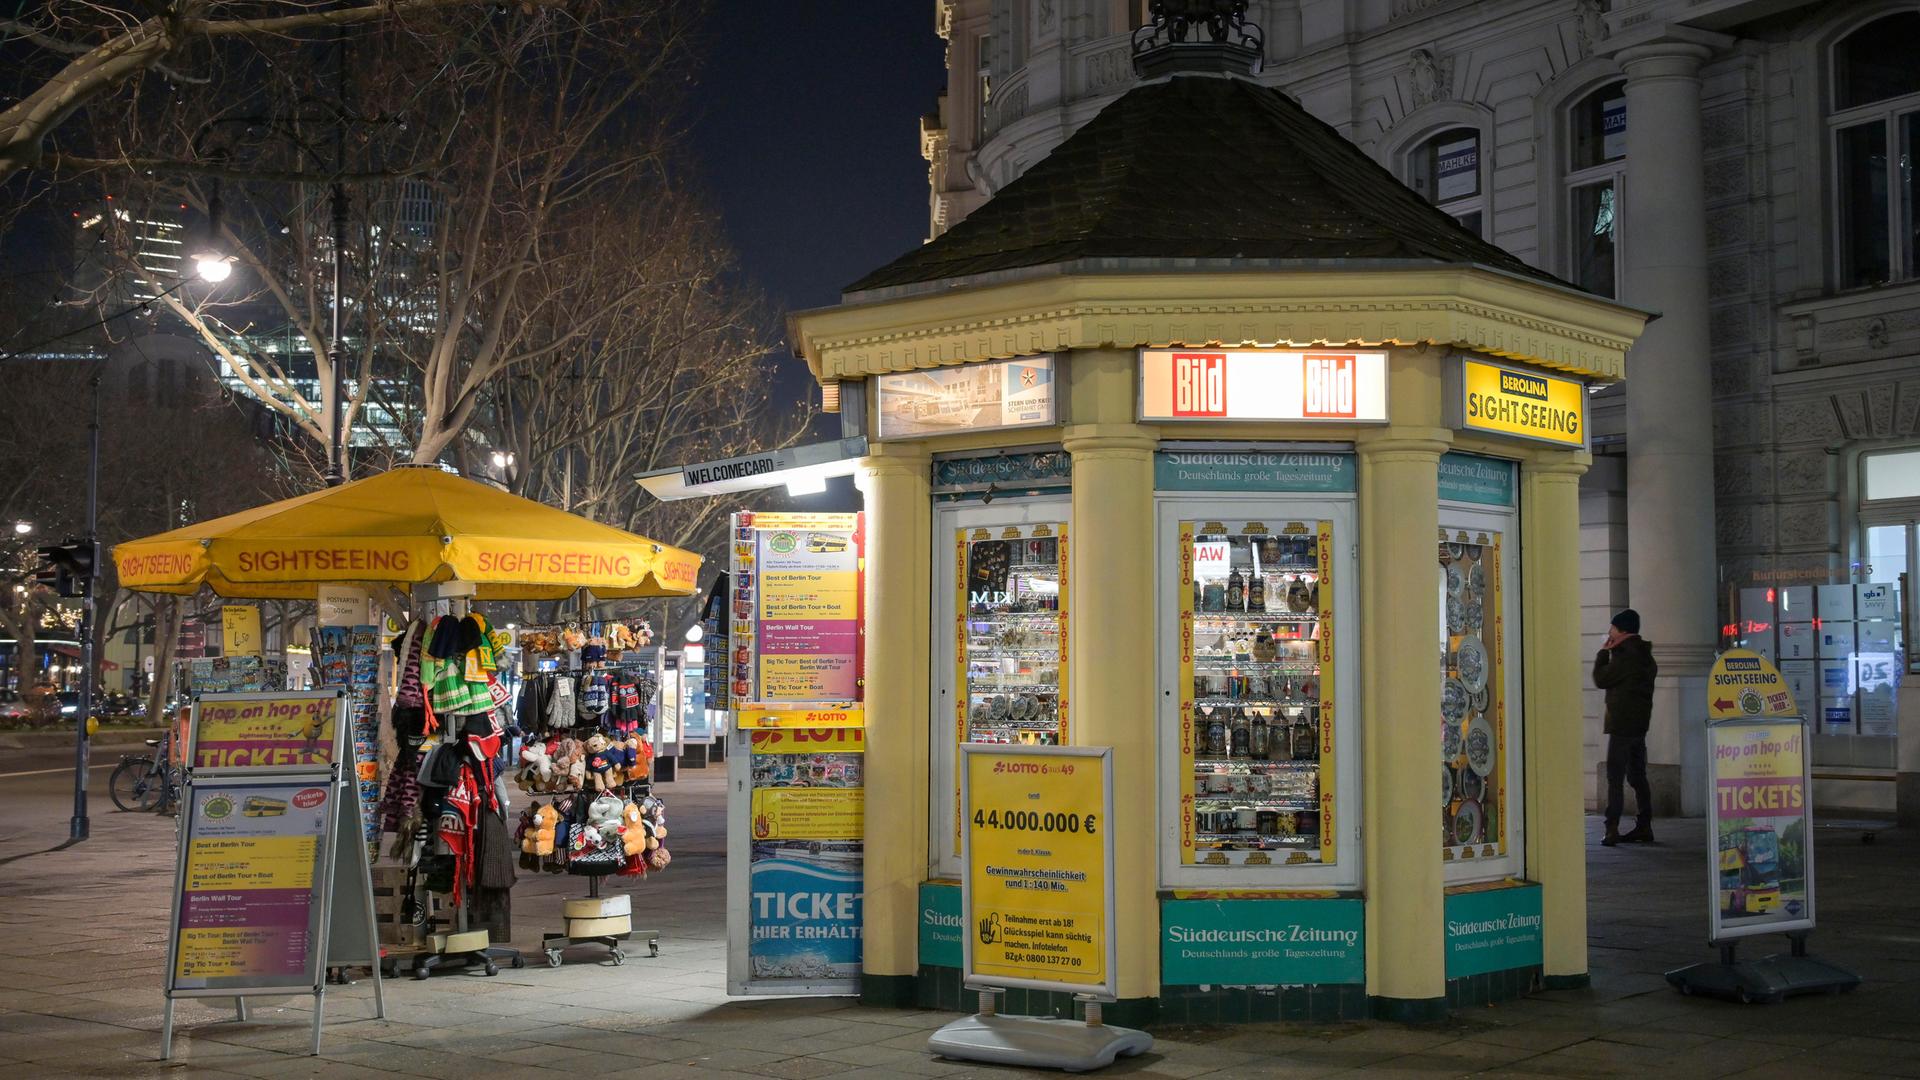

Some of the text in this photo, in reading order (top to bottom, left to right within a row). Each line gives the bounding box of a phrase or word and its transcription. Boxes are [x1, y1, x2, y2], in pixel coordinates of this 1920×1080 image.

[1439, 153, 1476, 173] MAHLKE
[1177, 358, 1223, 413] Bild
[1307, 360, 1353, 413] Bild
[1502, 375, 1547, 397] BEROLINA
[1469, 392, 1578, 435] SIGHTSEEING
[688, 458, 774, 485] WELCOMECARD
[1178, 470, 1332, 482] Deutschlands große Tageszeitung
[121, 553, 192, 576] SIGHTSEEING
[239, 549, 409, 572] SIGHTSEEING
[478, 552, 631, 577] SIGHTSEEING
[1321, 545, 1329, 585] LOTTO
[1323, 623, 1331, 662] LOTTO
[1727, 662, 1760, 670] BEROLINA
[1767, 692, 1788, 703] TICKETS
[1774, 702, 1786, 711] HIER
[202, 699, 333, 723] Hop on hop off
[818, 713, 848, 721] LOTTO
[200, 748, 329, 767] TICKETS
[1716, 735, 1800, 760] Hop on hop off
[1007, 763, 1039, 773] LOTTO
[1041, 764, 1048, 774] 6
[1061, 765, 1075, 775] 49
[296, 791, 323, 801] Tickets
[303, 800, 318, 808] hier
[1717, 783, 1803, 811] TICKETS
[974, 809, 1096, 834] 44.000.000 €
[1005, 880, 1022, 889] rund
[1024, 880, 1028, 889] 1
[1034, 881, 1048, 890] 140
[1004, 914, 1074, 927] Teilnahme erst ab 18!
[1448, 912, 1540, 937] Süddeutsche Zeitung
[753, 923, 863, 939] HIER ERHÄLT
[1004, 927, 1092, 943] Glücksspiel kann süchtig
[1169, 925, 1358, 946] Süddeutsche Zeitung
[1004, 940, 1068, 952] machen. Infotelefon
[1182, 949, 1345, 959] Deutschlands große Tageszeitung
[1005, 952, 1082, 966] BZgA: 0800 137 27 00
